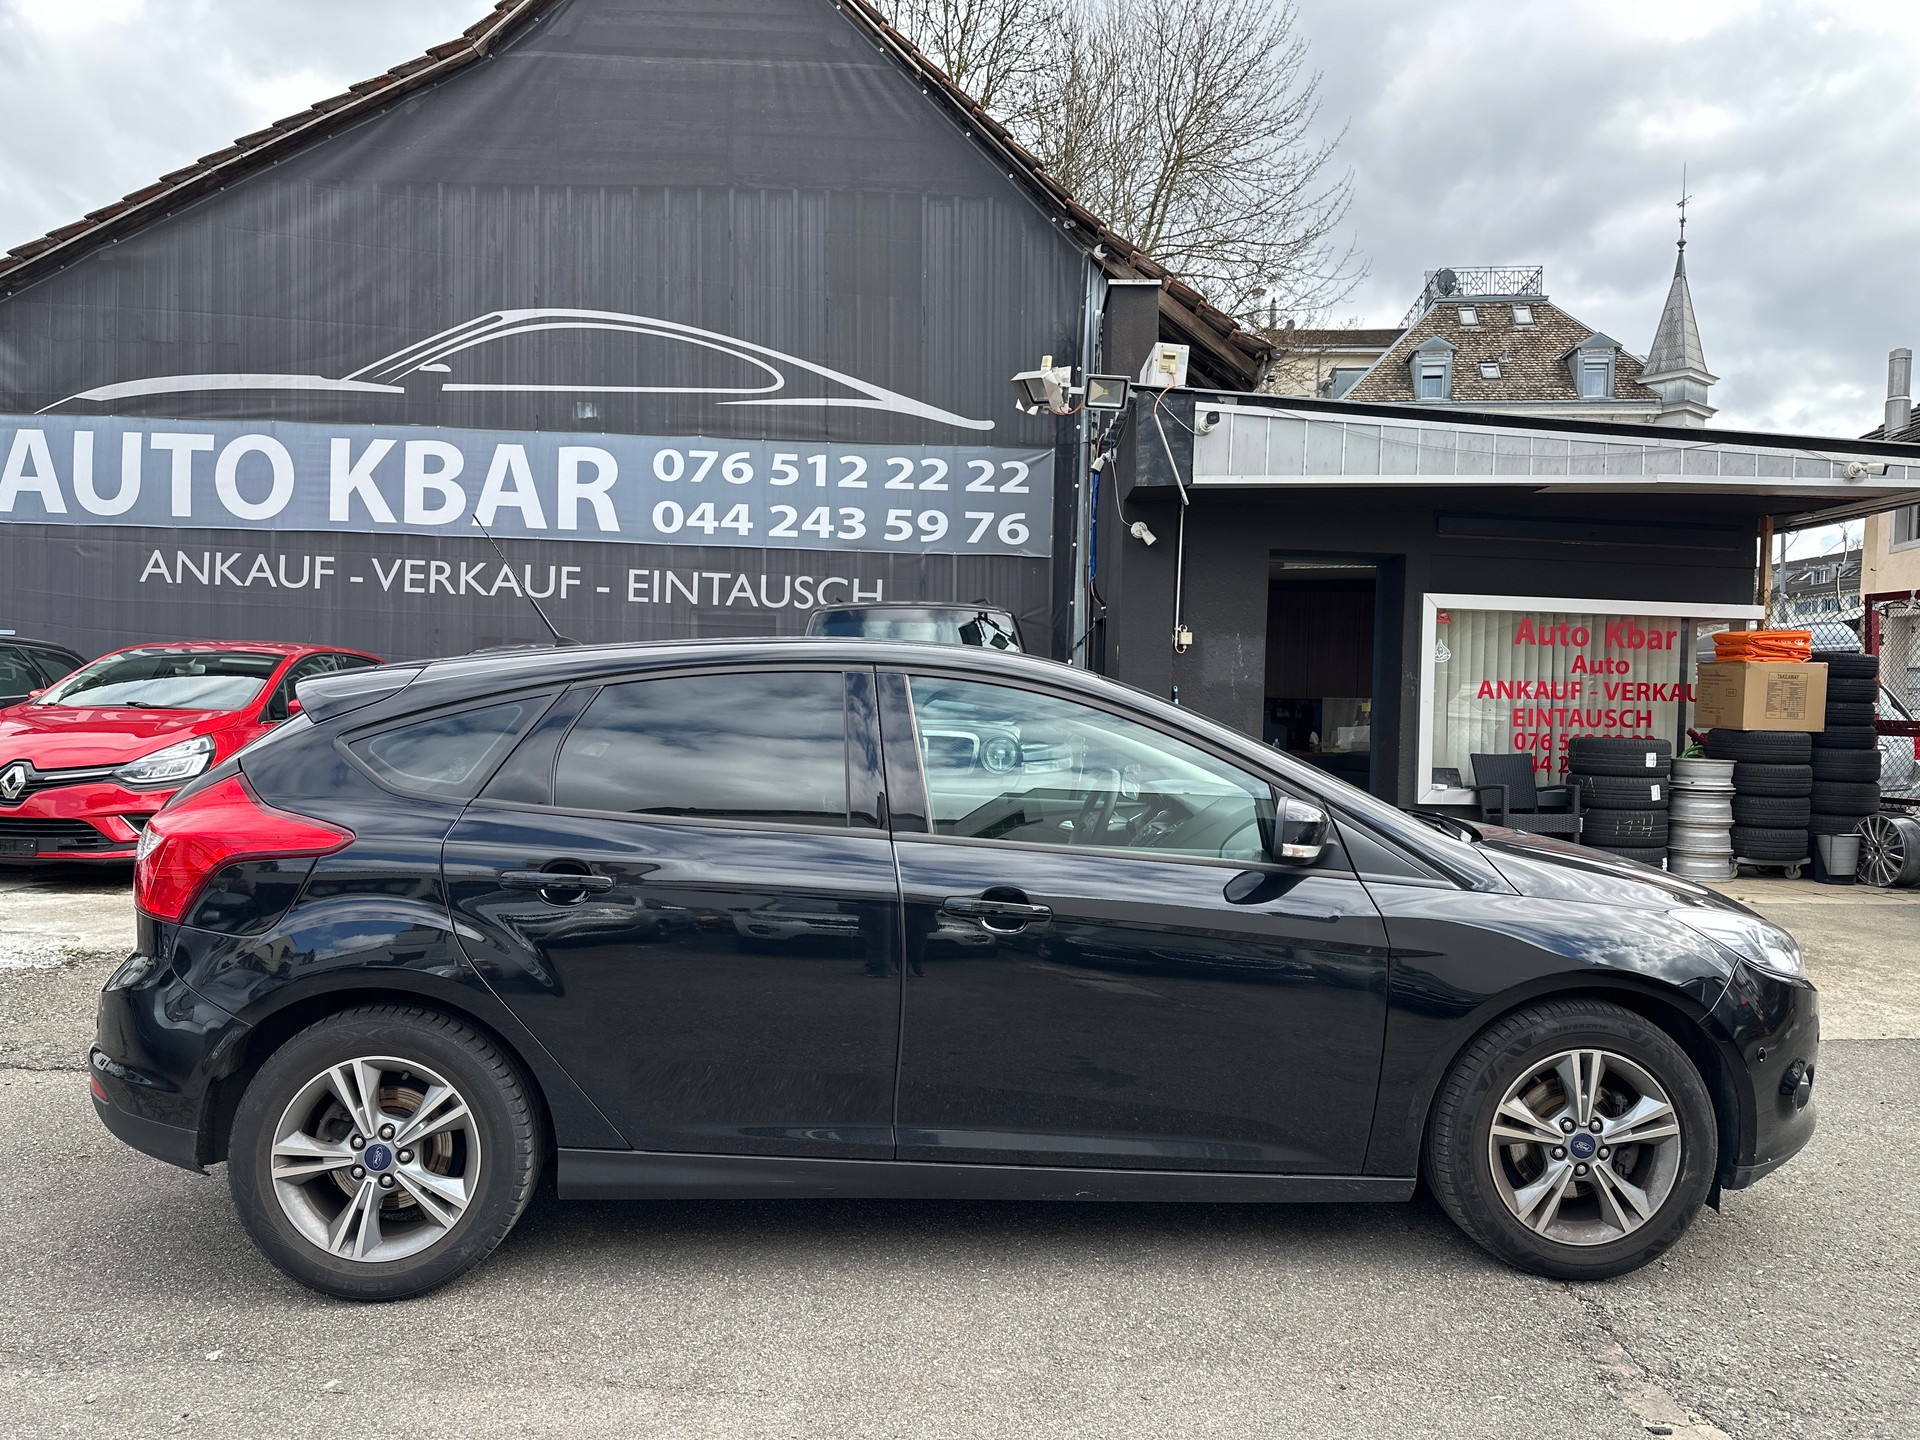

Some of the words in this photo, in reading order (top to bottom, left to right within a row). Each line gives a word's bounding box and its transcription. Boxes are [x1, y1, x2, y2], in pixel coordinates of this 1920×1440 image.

[0, 428, 296, 521] AUTO
[329, 437, 622, 533] KBAR
[652, 448, 755, 485] 076
[769, 452, 868, 489] 512
[884, 456, 950, 491] 22
[965, 459, 1031, 494] 22
[651, 500, 754, 536] 044
[768, 504, 868, 540] 243
[883, 508, 949, 543] 59
[964, 511, 1031, 546] 76
[139, 549, 335, 590] ANKAUF
[627, 568, 884, 610] EINTAUSCH
[1515, 617, 1590, 648] Auto
[1605, 618, 1678, 651] Kbar
[1571, 655, 1630, 675] Auto
[1477, 680, 1584, 701] ANKAUF
[1512, 707, 1653, 729] EINTAUSCH
[1513, 731, 1553, 751] 076
